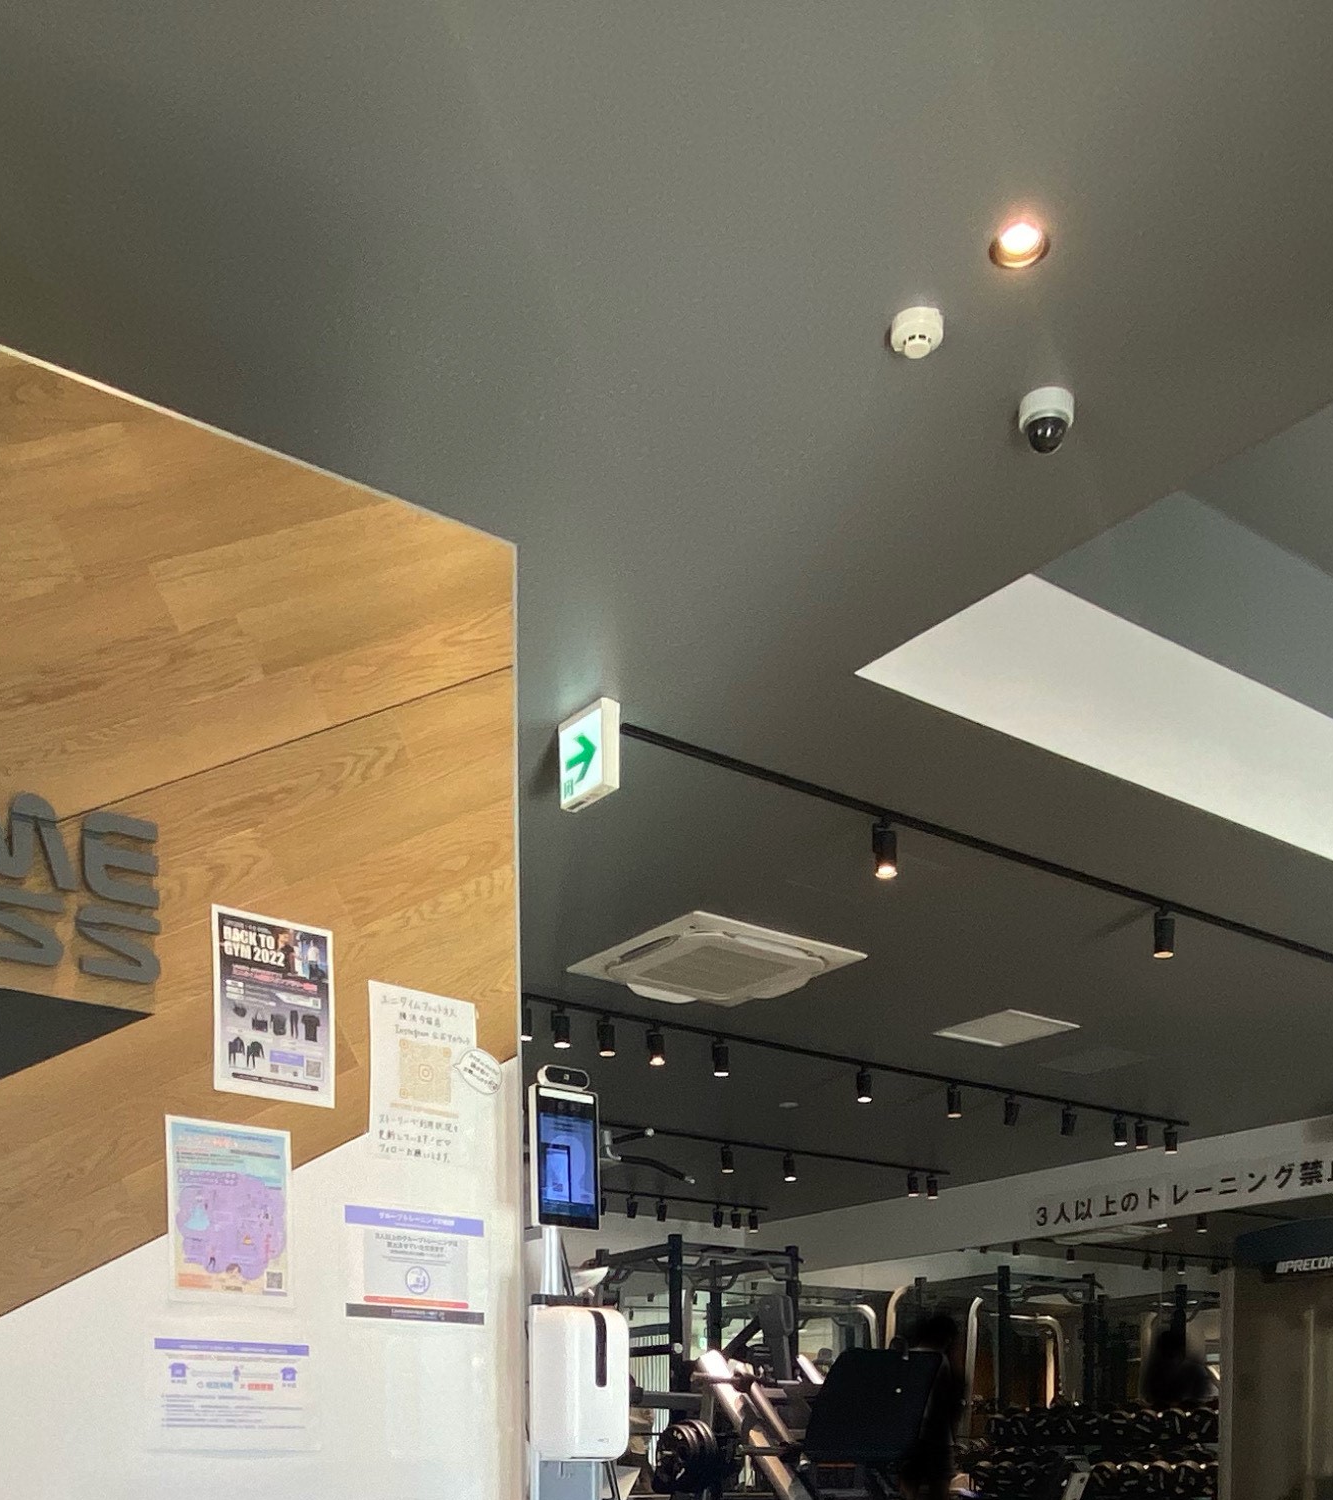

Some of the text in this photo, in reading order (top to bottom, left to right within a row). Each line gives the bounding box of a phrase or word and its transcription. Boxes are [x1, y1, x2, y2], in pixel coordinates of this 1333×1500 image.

[223, 926, 258, 948] BACK
[258, 934, 275, 951] TO
[224, 941, 285, 967] GYM 2022
